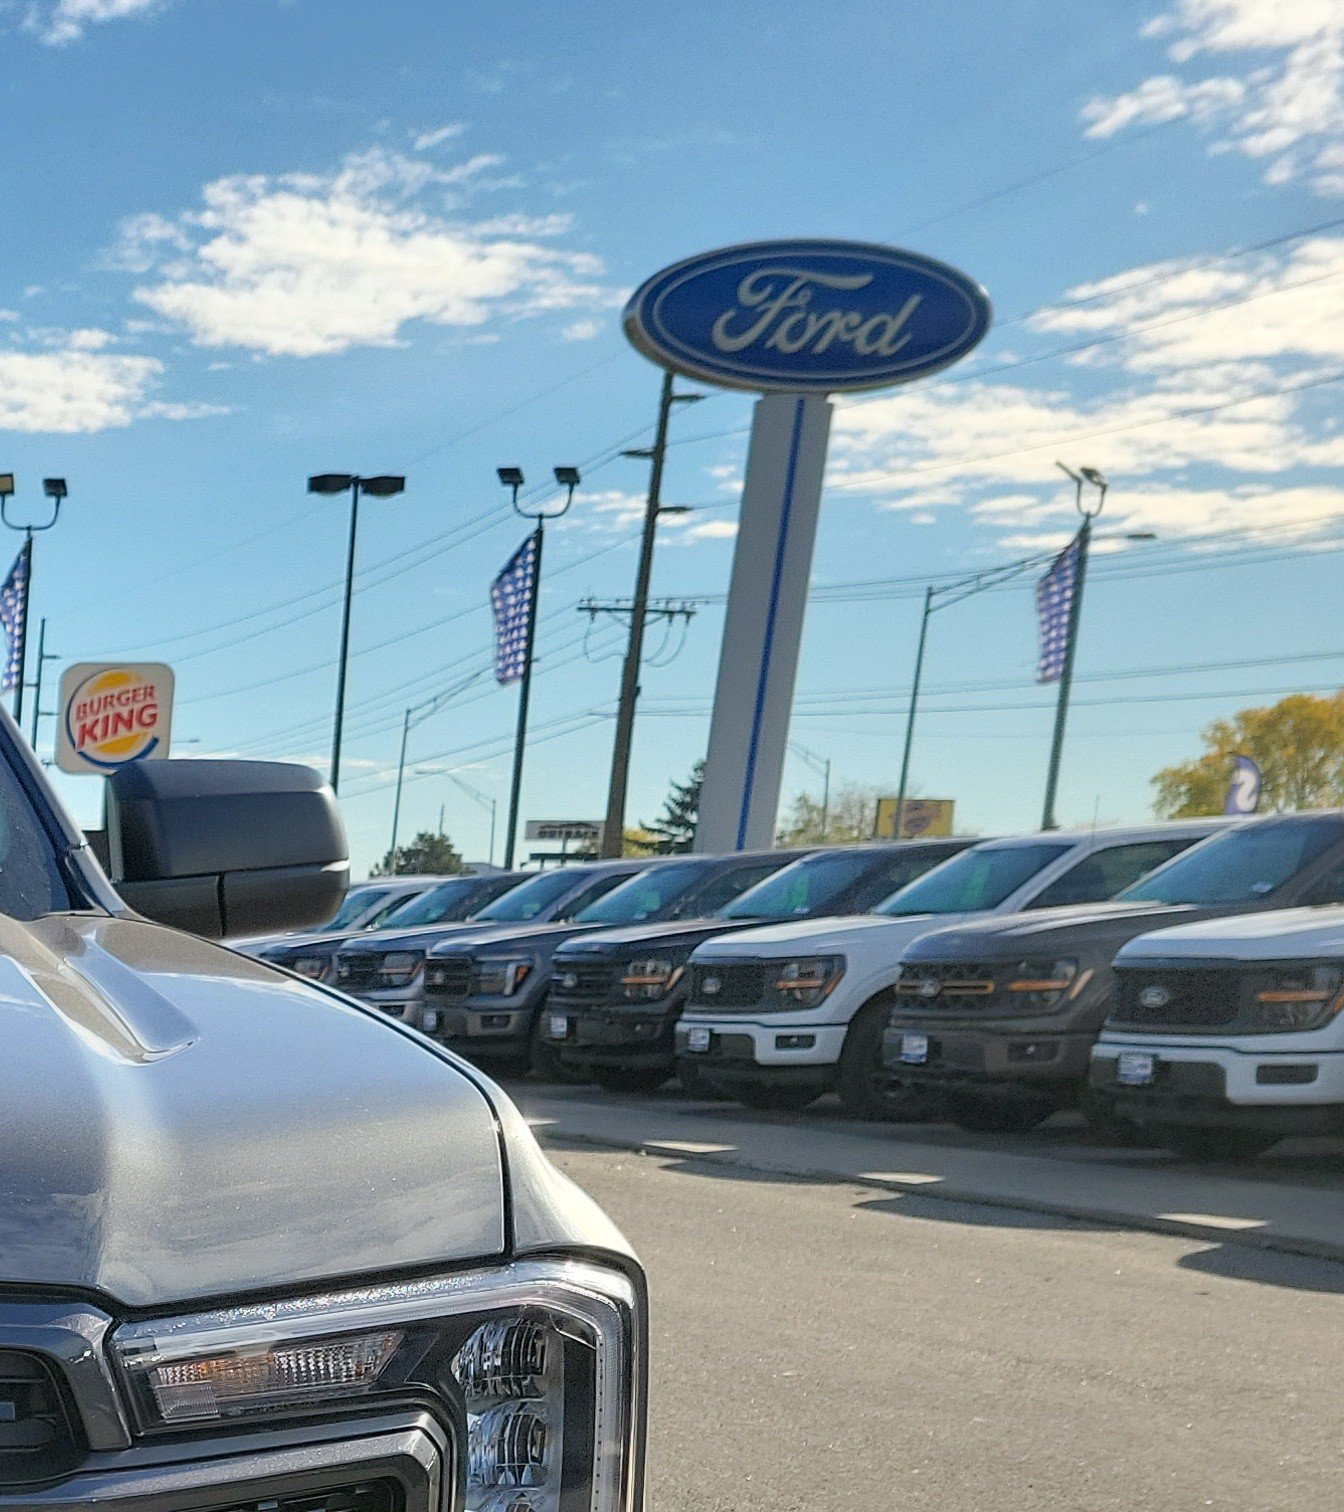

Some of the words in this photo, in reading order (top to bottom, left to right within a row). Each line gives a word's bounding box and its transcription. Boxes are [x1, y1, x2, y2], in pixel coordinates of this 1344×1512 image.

[713, 268, 922, 356] Ford
[75, 683, 156, 721] BURGER
[75, 703, 158, 750] KING
